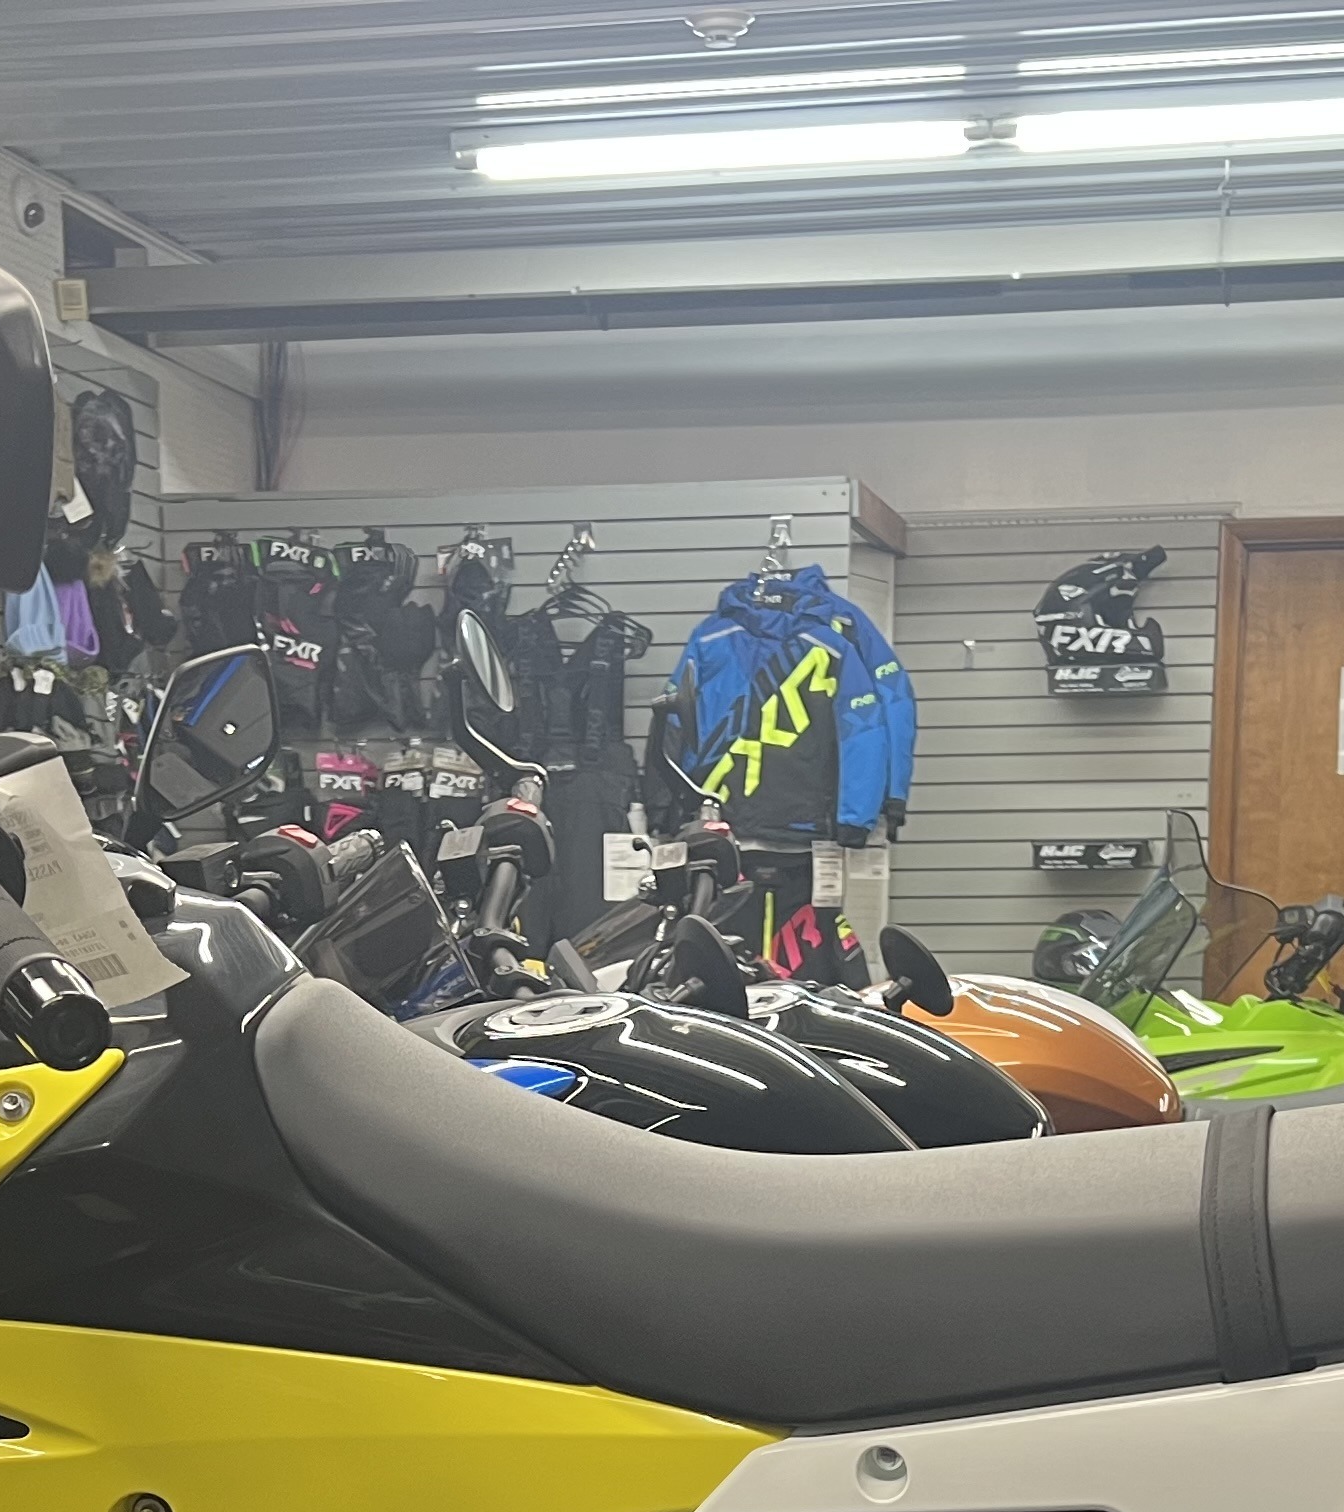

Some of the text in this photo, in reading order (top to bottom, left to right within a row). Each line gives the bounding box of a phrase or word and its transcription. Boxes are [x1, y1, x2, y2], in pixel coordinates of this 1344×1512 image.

[201, 547, 226, 561] FX
[271, 541, 311, 564] FXR
[273, 634, 323, 663] FXR
[1051, 625, 1132, 654] FXR
[320, 773, 362, 791] FXR
[435, 772, 478, 790] FXR
